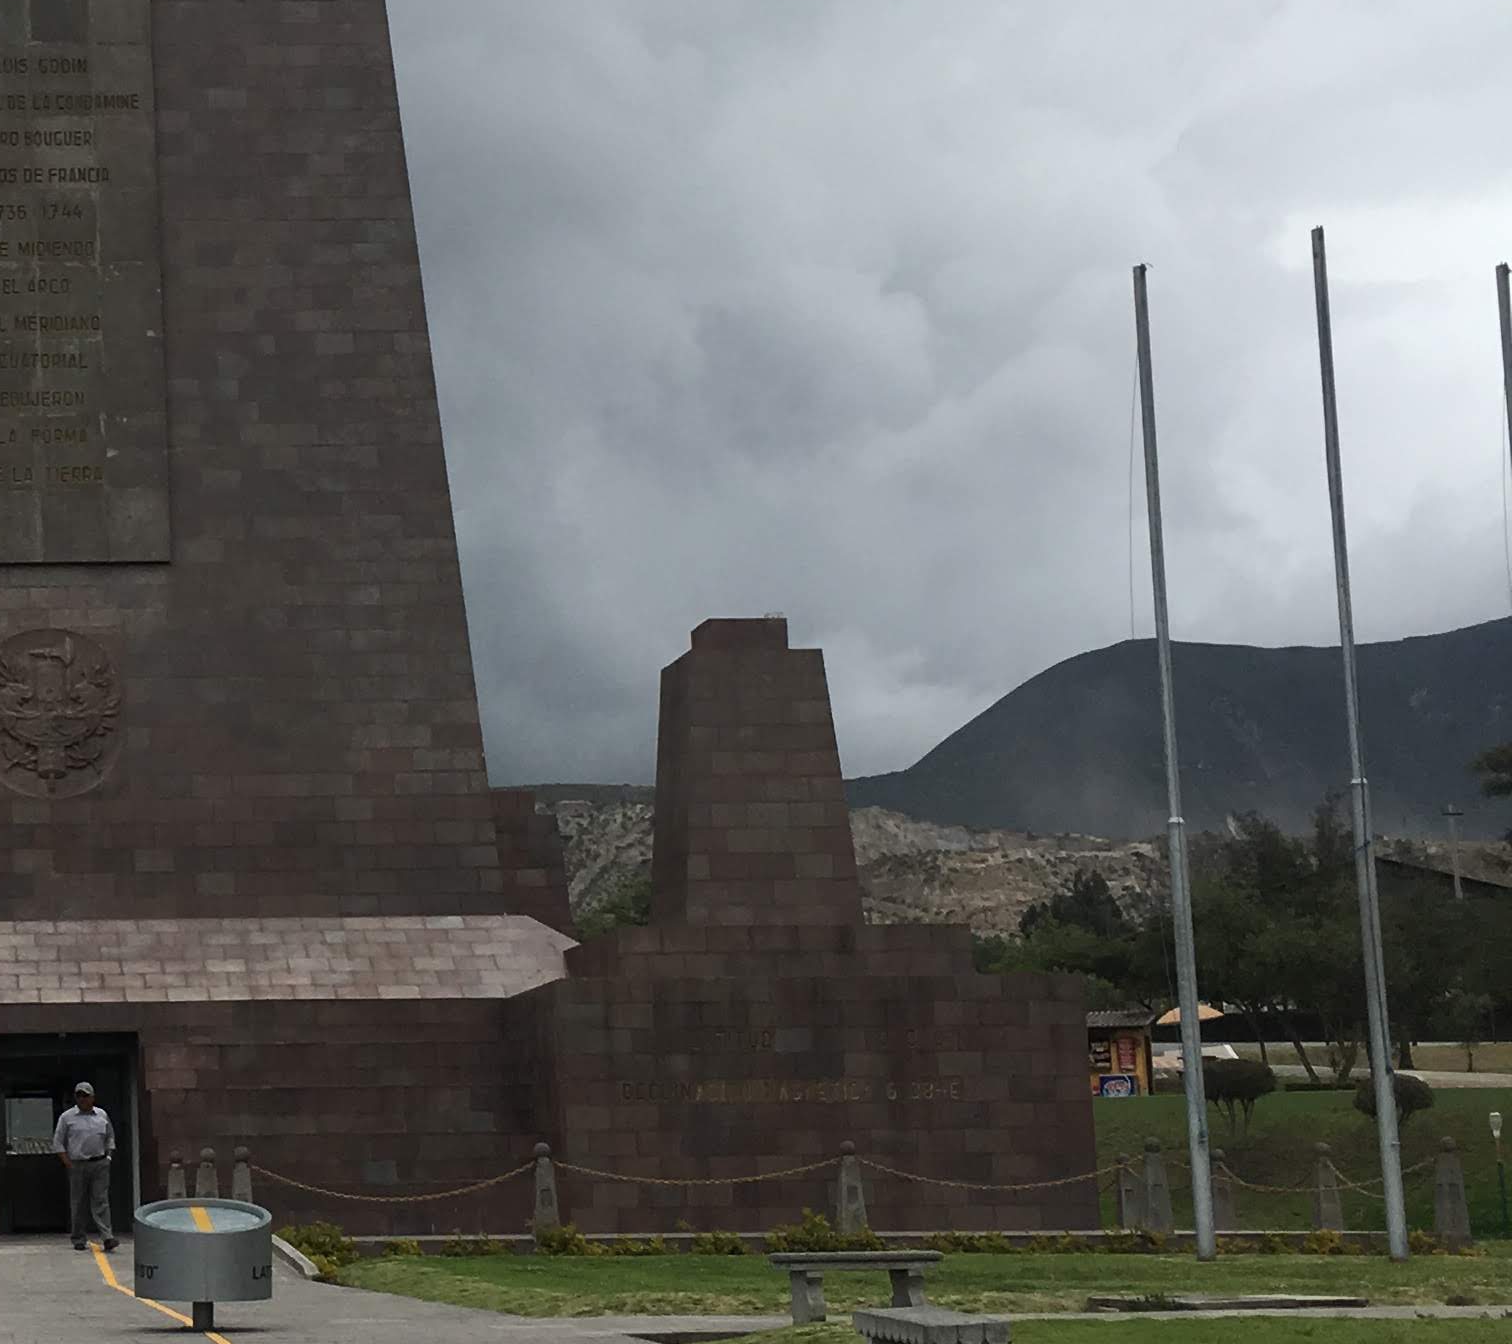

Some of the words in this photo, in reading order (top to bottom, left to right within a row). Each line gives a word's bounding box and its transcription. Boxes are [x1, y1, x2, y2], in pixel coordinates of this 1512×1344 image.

[38, 57, 89, 74] GODIN
[7, 94, 27, 111] DE
[32, 94, 51, 111] LA
[57, 93, 141, 111] CONDAMINE
[24, 130, 93, 147] BOUGUER
[23, 167, 44, 184] DE
[48, 166, 110, 183] FRANCIA
[17, 241, 95, 257] MIDIENDO
[2, 278, 22, 295] EL
[27, 278, 71, 295] ARCO
[14, 315, 101, 332] MERIDIANO
[31, 428, 88, 444] FORMA
[12, 466, 33, 482] LA
[45, 465, 104, 482] TIERRA
